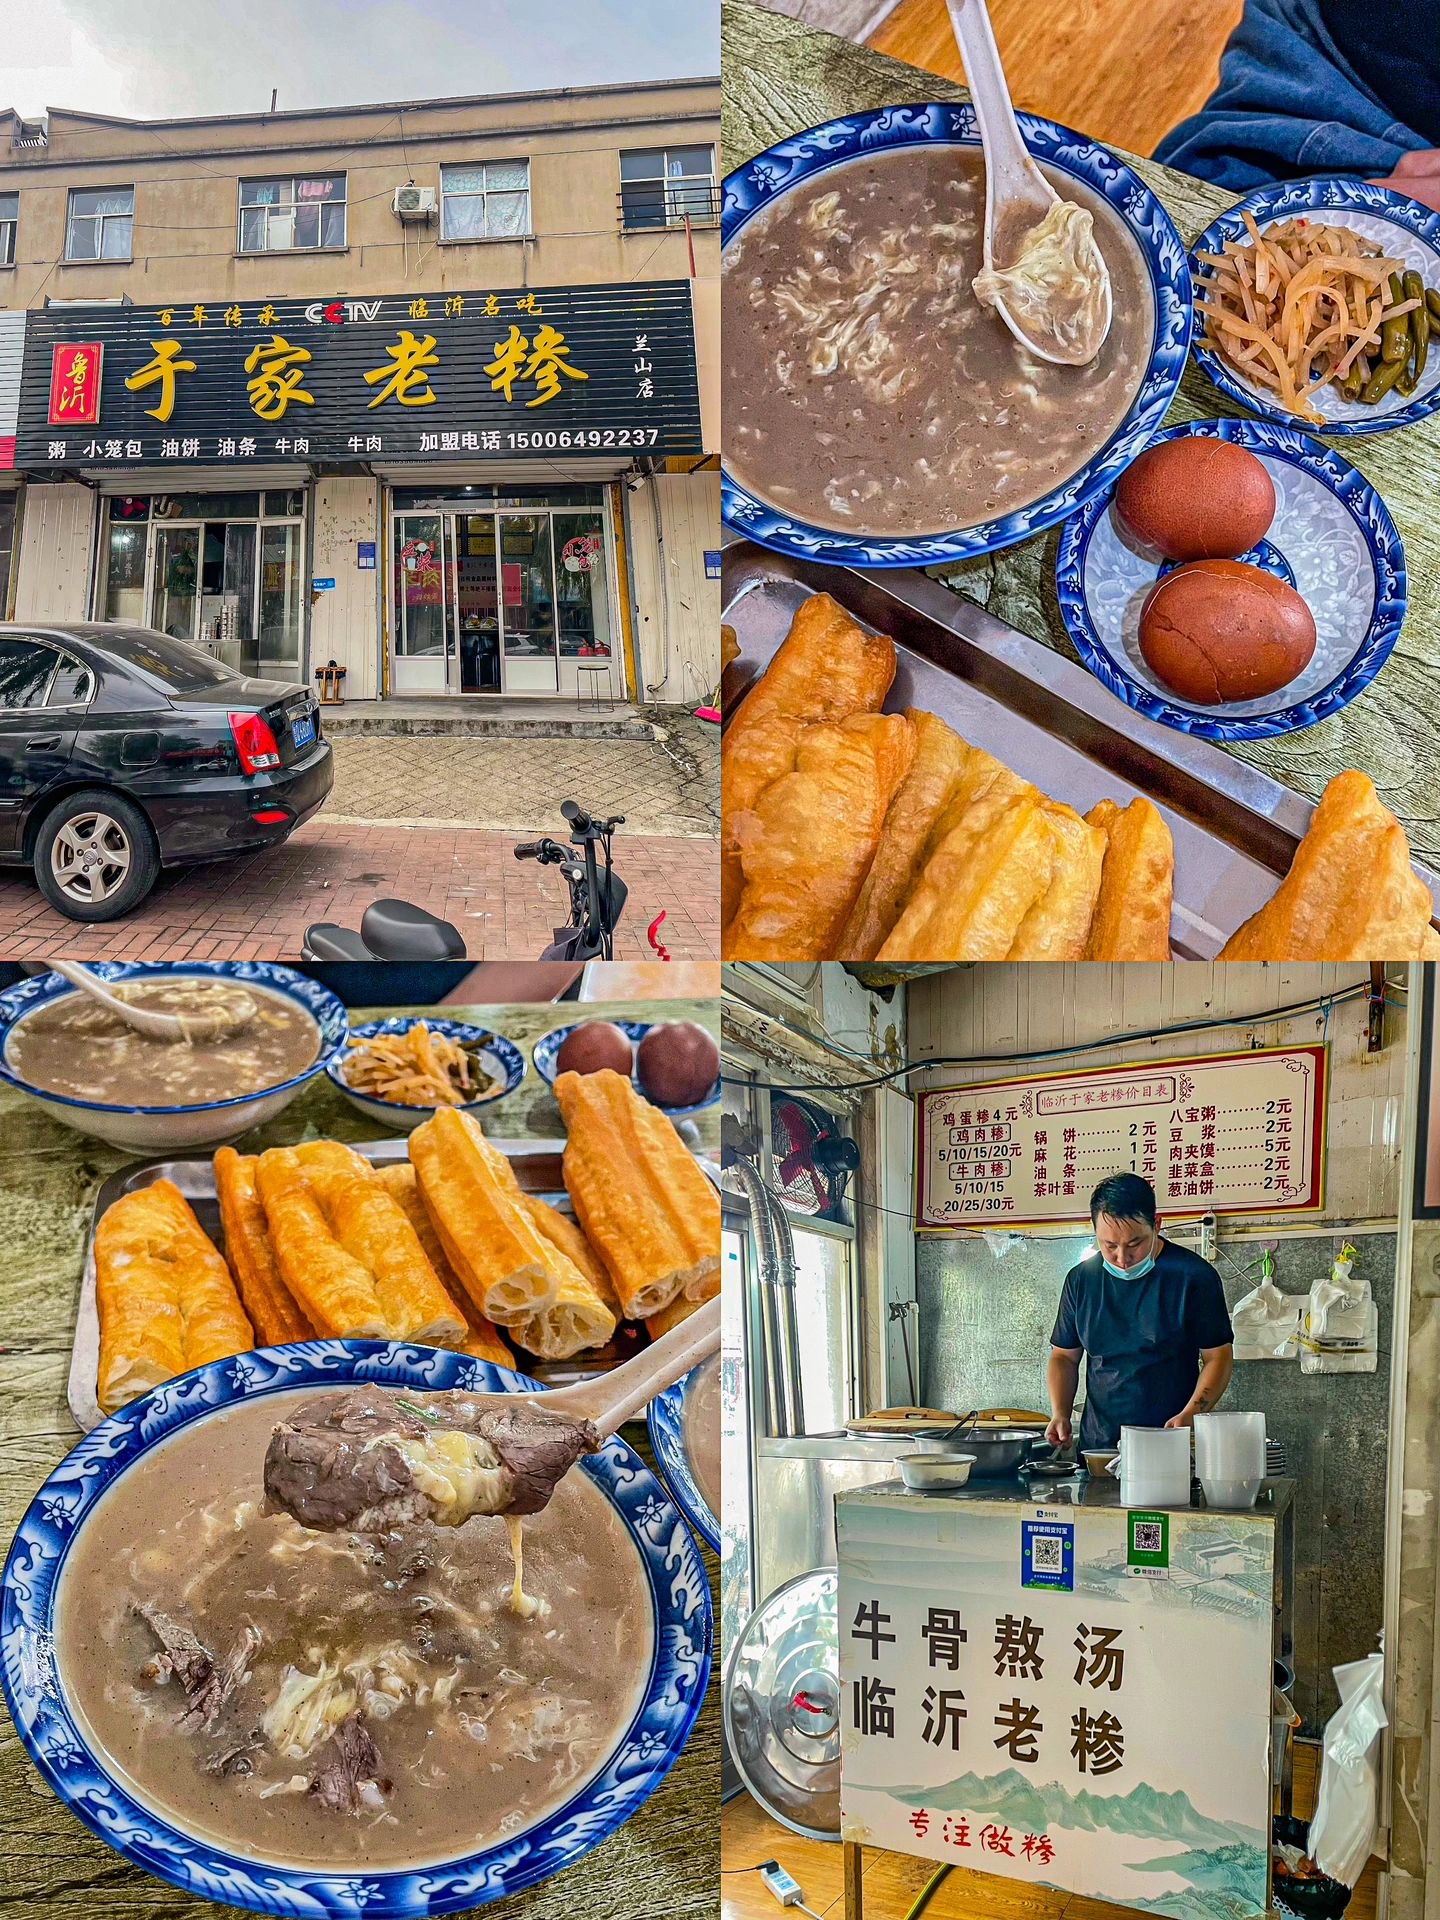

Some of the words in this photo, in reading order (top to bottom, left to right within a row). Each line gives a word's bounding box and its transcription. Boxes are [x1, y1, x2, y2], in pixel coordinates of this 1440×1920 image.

[156, 304, 281, 328] 百年传承
[305, 300, 382, 324] CCTV
[408, 293, 543, 318] 临沂名吃
[124, 324, 590, 424] 于家老糁
[632, 334, 655, 399] 兰山店
[59, 351, 89, 414] 鲁沂
[48, 441, 66, 459] 粥
[83, 439, 143, 459] 小笼包
[160, 438, 200, 458] 油饼
[217, 437, 258, 456] 油条
[275, 436, 310, 454] 牛肉
[348, 435, 382, 452] 牛肉
[419, 430, 501, 452] 加盟电话
[507, 429, 659, 449] 15006492237
[1041, 1083, 1169, 1108] 临沂于家老糁价目表
[1169, 1105, 1216, 1124] 八宝粥
[1265, 1098, 1292, 1114] 2元
[1265, 1117, 1292, 1133] 2元
[938, 1143, 1022, 1161] 5/10/15/20元
[1169, 1142, 1215, 1161] 肉夹馍
[1264, 1136, 1291, 1152] 5元
[1168, 1160, 1215, 1179] 韭菜盒
[1264, 1155, 1291, 1171] 2元
[955, 1181, 1004, 1195] 5/10/15
[1034, 1180, 1076, 1197] 茶叶蛋
[1168, 1179, 1215, 1197] 葱油饼
[1263, 1174, 1290, 1190] 2元
[944, 1197, 1014, 1212] 20/25/30元
[851, 1600, 1126, 1692] 牛骨熬汤
[852, 1676, 1126, 1777] 临沂老糁
[908, 1808, 1057, 1866] 专注做糁
